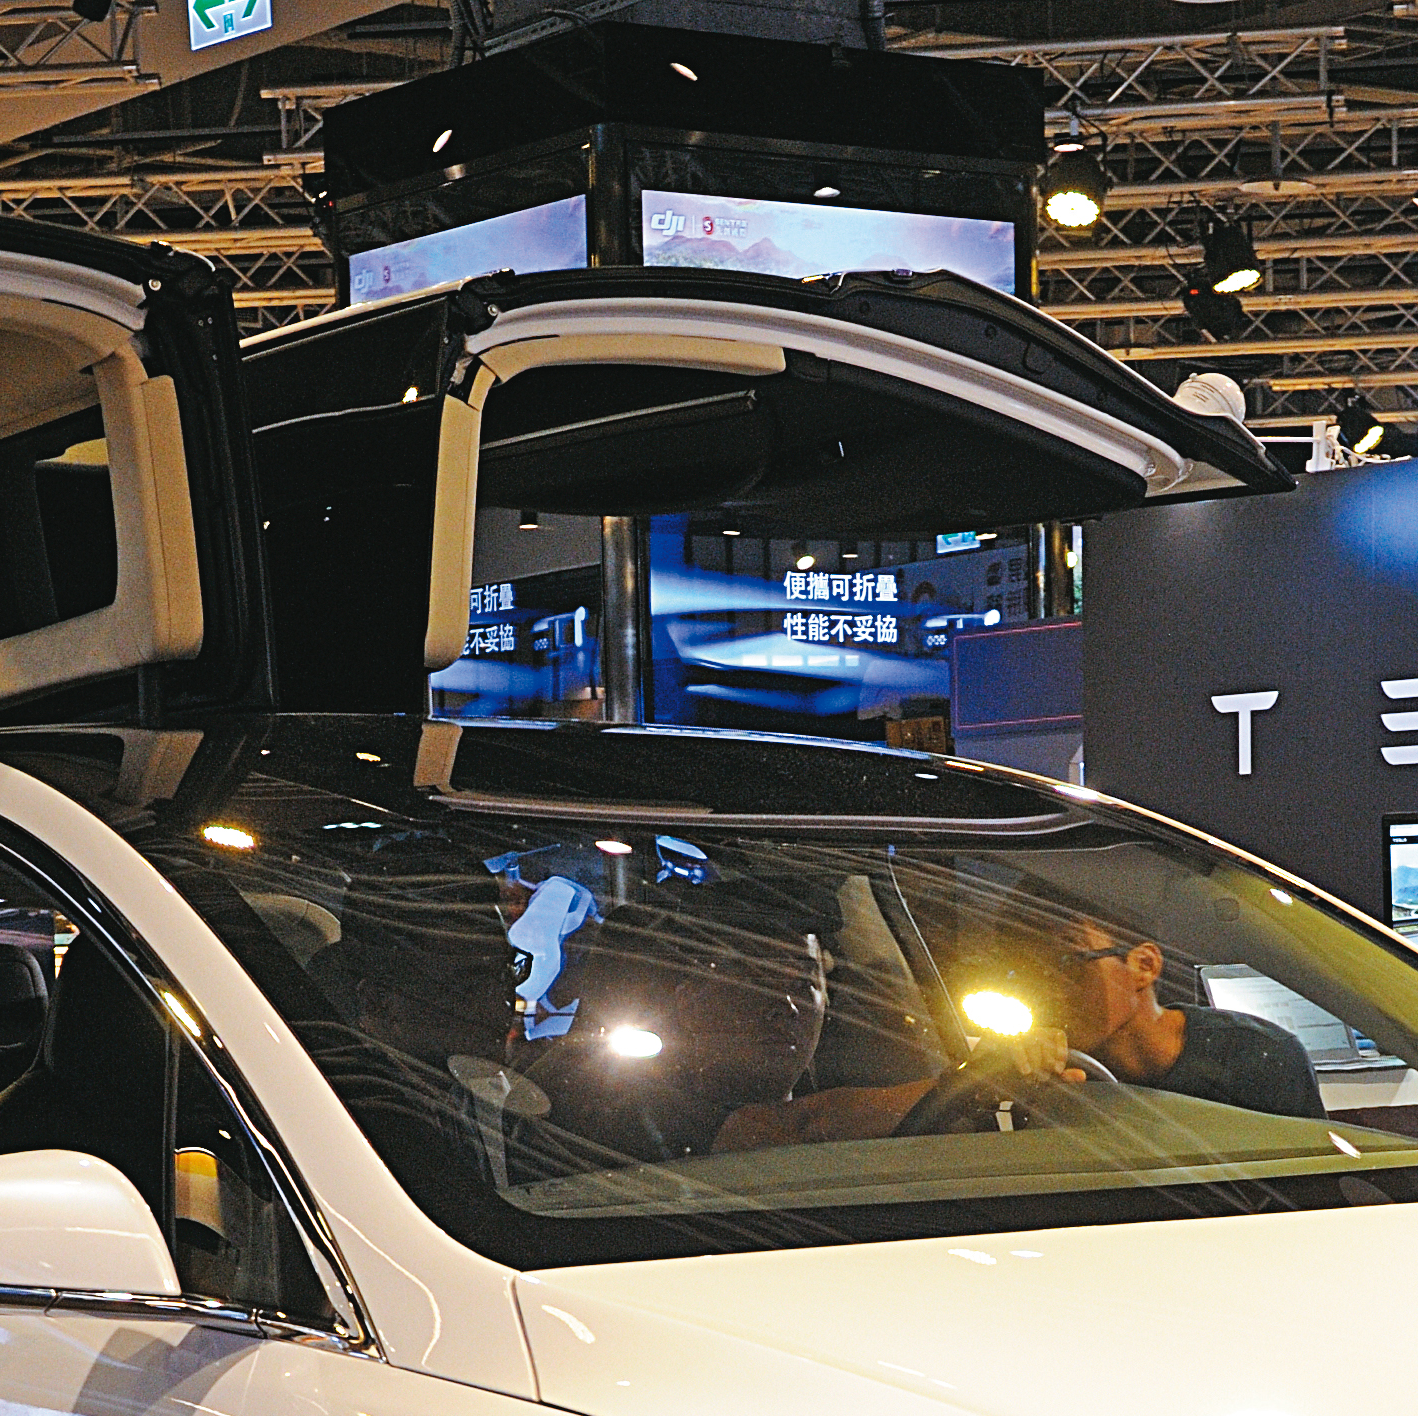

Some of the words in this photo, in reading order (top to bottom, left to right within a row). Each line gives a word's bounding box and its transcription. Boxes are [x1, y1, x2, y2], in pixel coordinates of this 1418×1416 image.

[783, 571, 898, 601] 便攜可折疊
[783, 612, 898, 643] 性能不妥協
